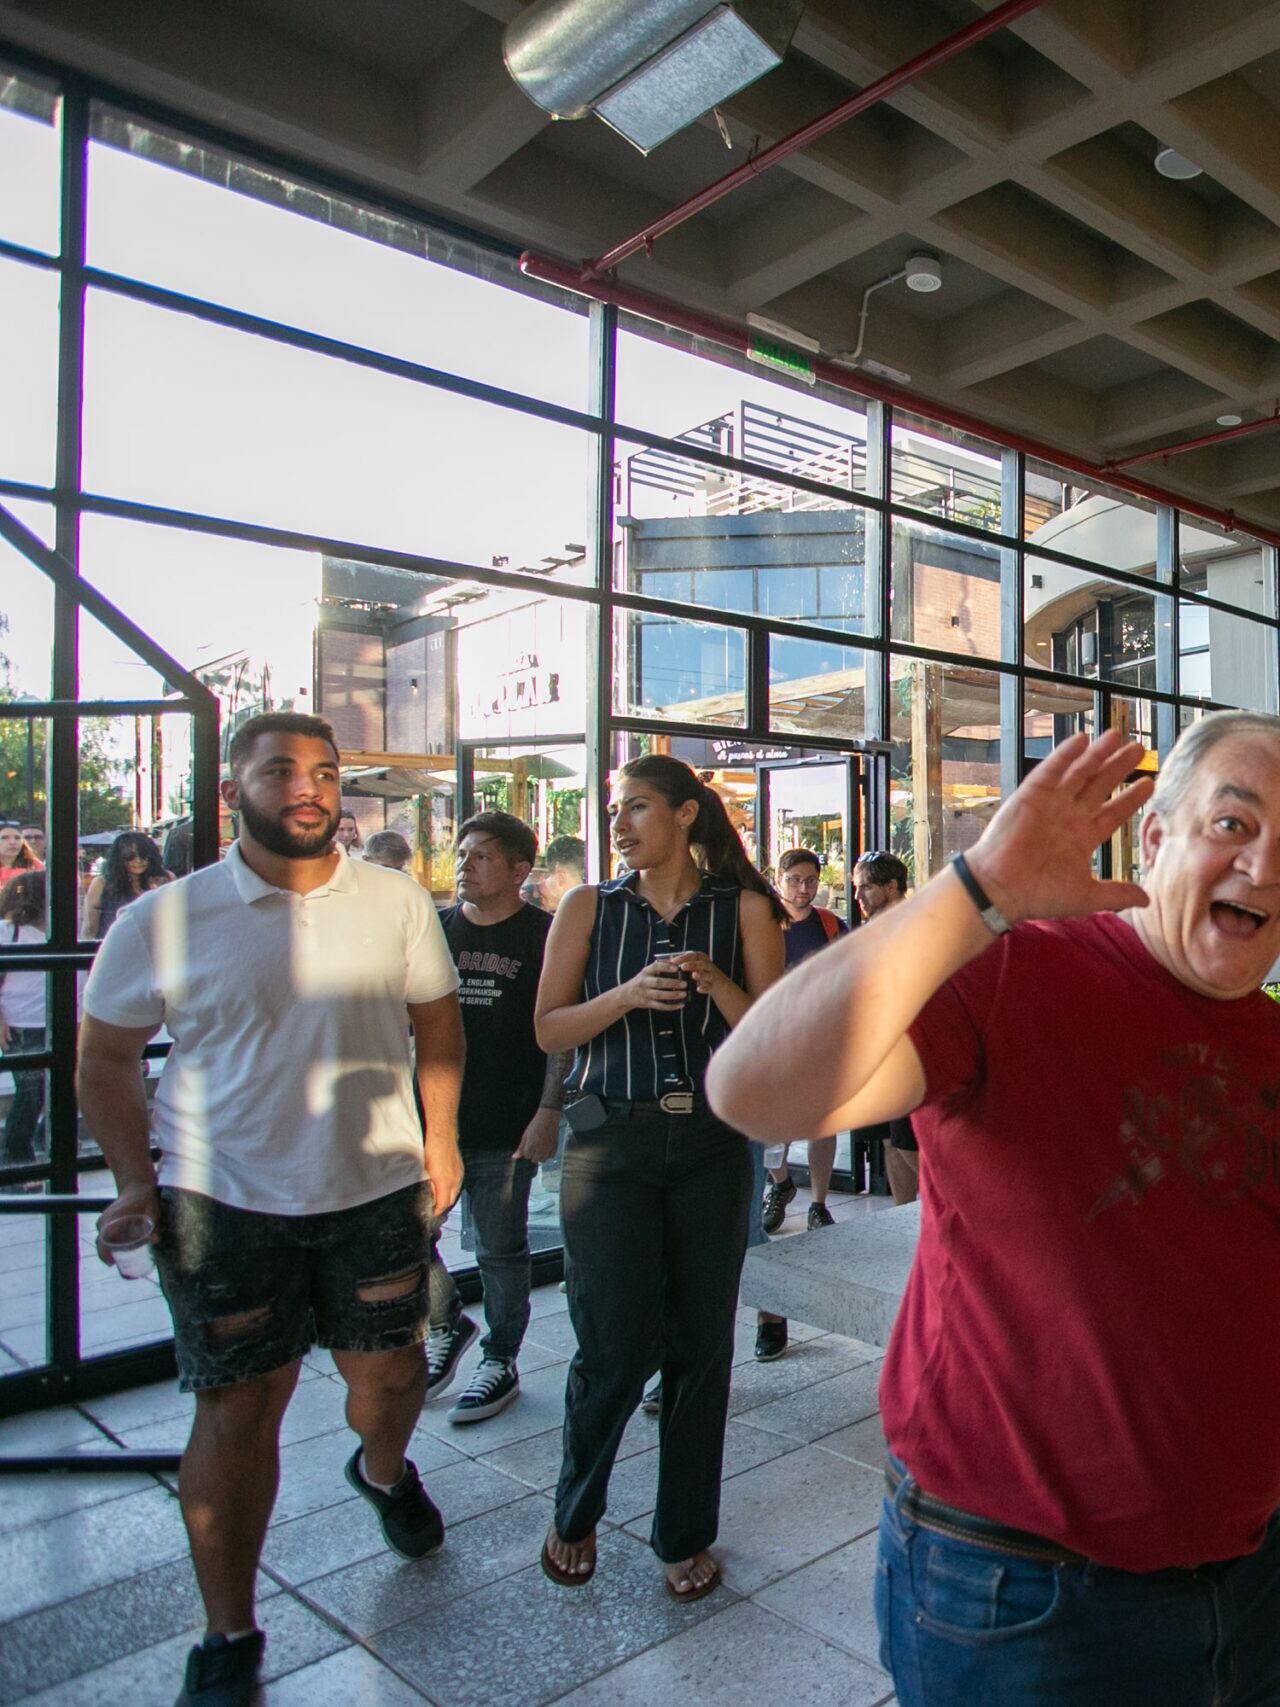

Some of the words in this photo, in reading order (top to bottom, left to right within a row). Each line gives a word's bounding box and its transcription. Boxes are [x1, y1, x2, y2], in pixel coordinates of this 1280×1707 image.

[458, 951, 522, 979] BRIDGE
[466, 978, 495, 987] ENGLAND
[466, 997, 493, 1006] SERVICE
